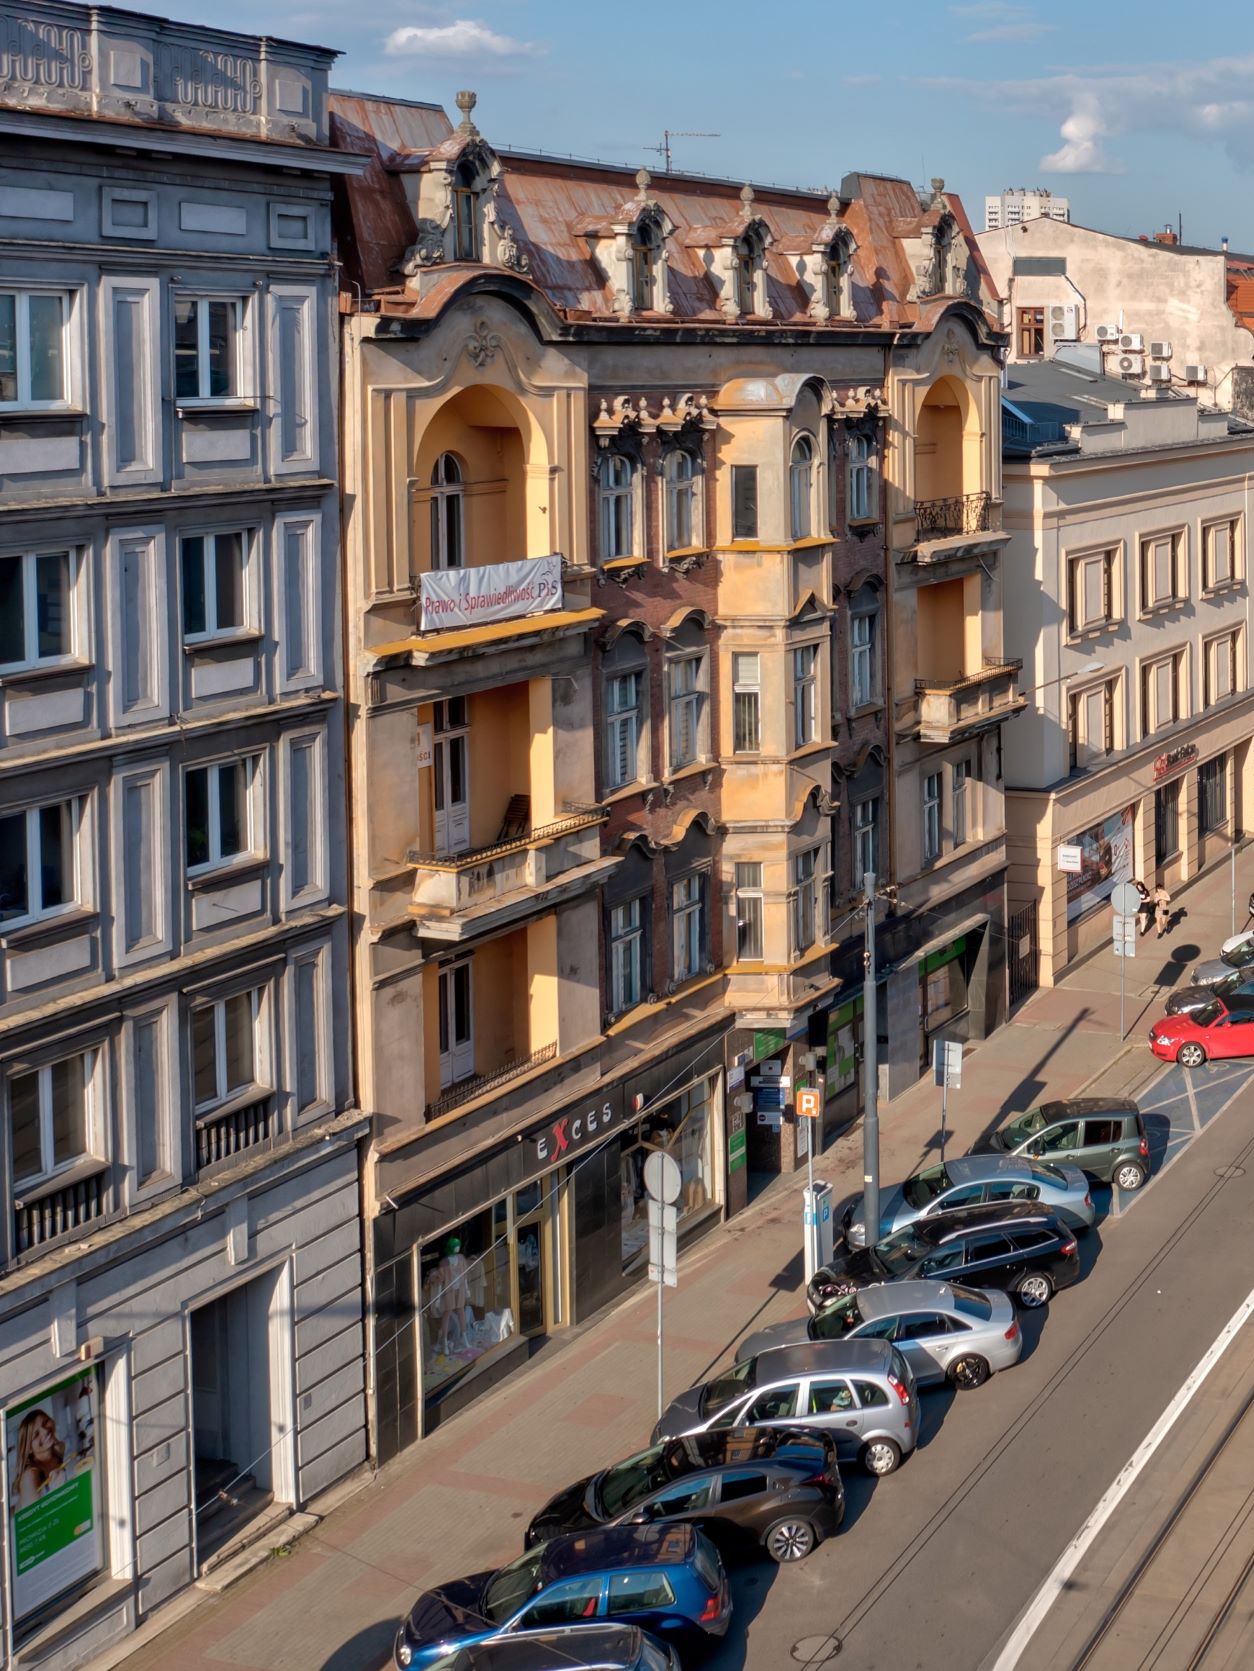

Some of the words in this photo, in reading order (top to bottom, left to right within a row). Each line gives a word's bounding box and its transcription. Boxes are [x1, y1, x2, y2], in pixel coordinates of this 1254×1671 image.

[425, 596, 456, 615] Prawo
[464, 580, 535, 615] Sprawiedliwość
[538, 580, 558, 598] PiS
[803, 1095, 814, 1112] P
[537, 1102, 611, 1162] EXCES
[823, 1208, 829, 1220] P
